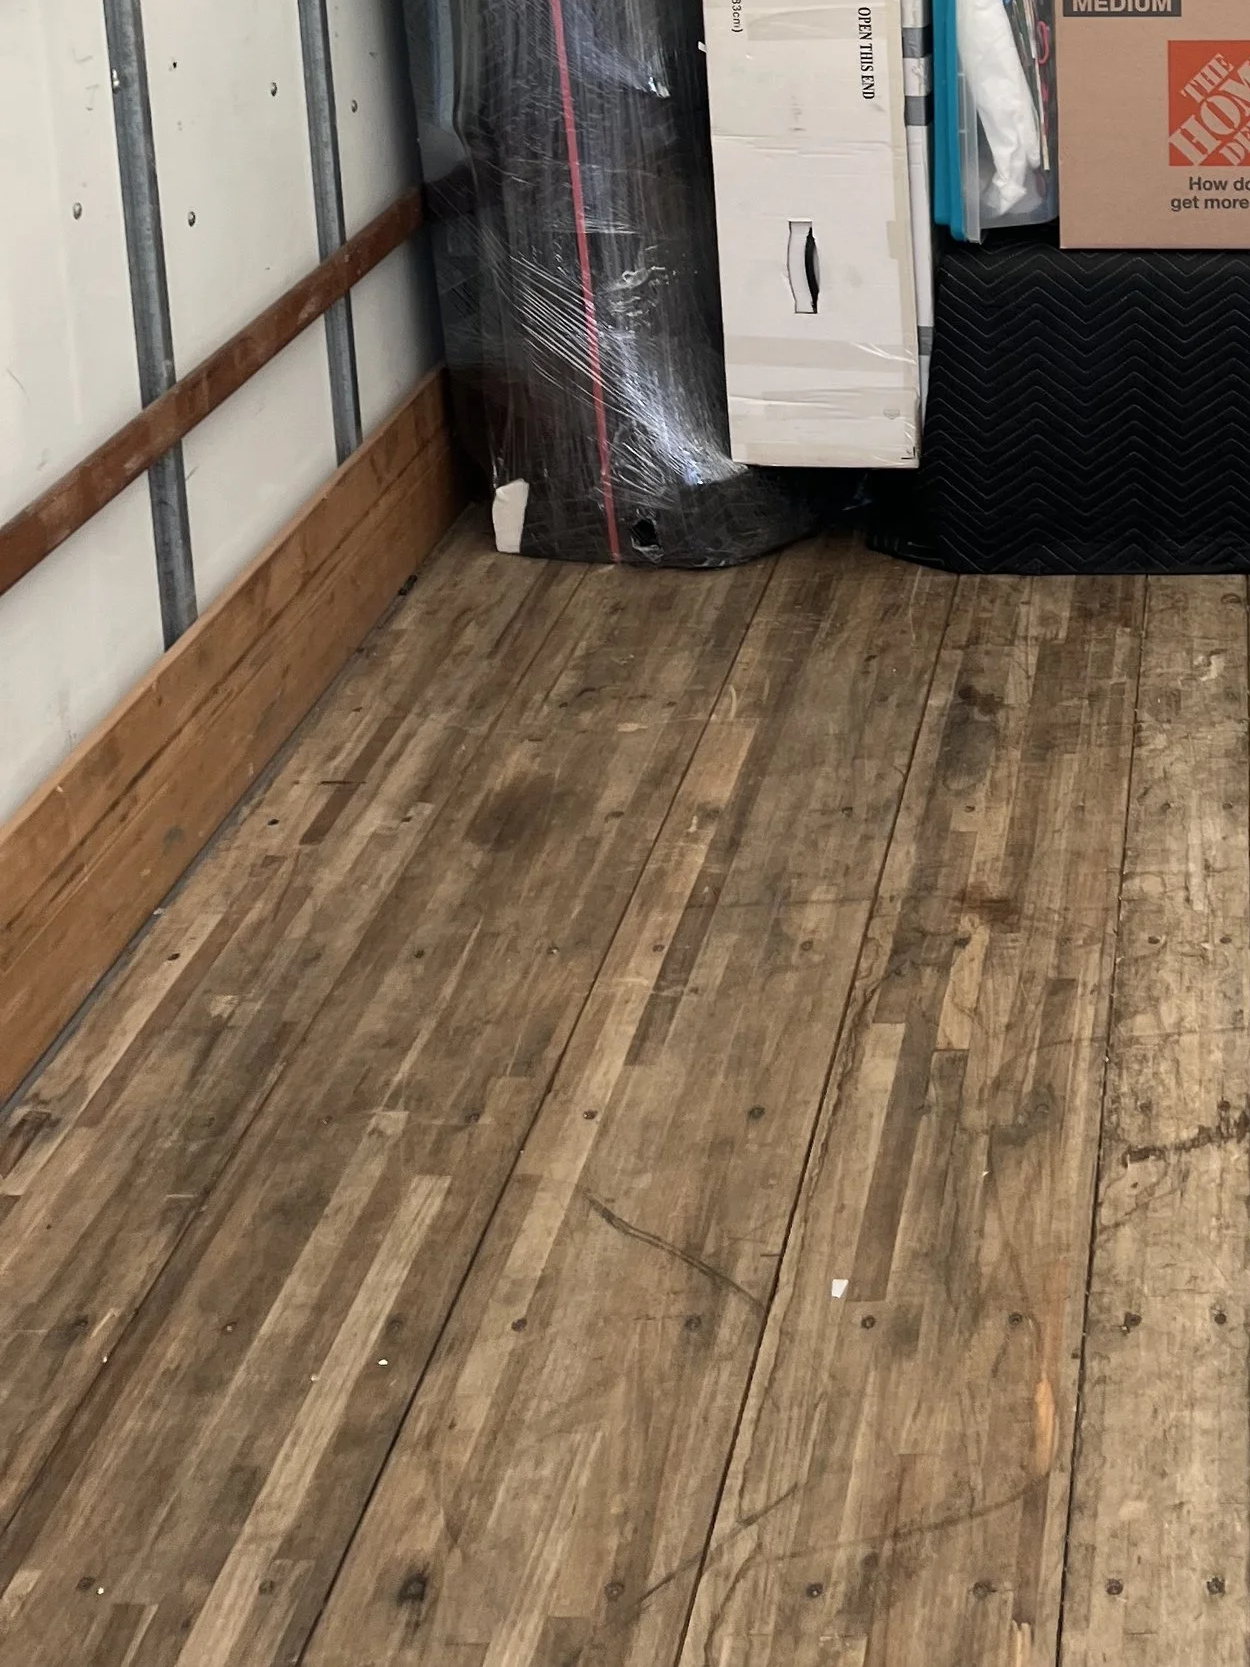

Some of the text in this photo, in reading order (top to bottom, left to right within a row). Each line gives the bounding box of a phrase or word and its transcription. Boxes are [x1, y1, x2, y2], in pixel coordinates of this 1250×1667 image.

[858, 6, 875, 99] OPEN THIS END
[1179, 53, 1234, 103] THE
[1189, 176, 1228, 191] How
[1171, 196, 1200, 212] get
[1204, 198, 1250, 209] more
